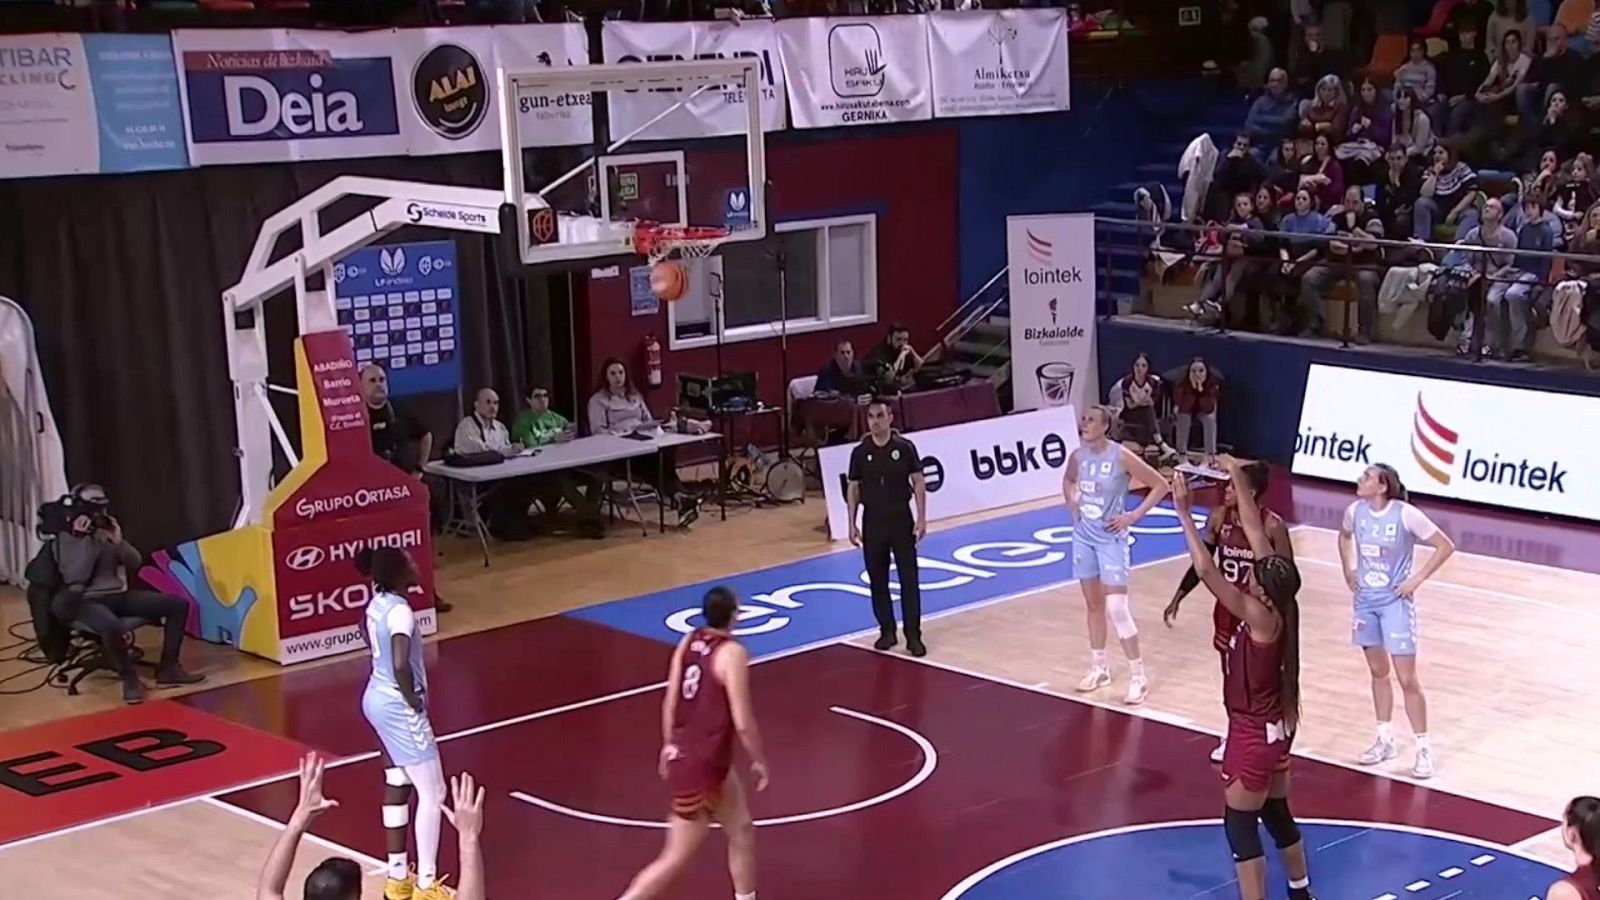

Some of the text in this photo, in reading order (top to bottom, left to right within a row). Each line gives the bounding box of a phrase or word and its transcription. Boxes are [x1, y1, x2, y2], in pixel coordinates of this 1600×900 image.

[429, 65, 476, 102] ALAI
[223, 73, 363, 137] Deia
[841, 110, 888, 122] GERNIKA
[458, 211, 487, 224] Sports
[1024, 266, 1083, 285] lointek
[1024, 326, 1085, 341] Bizkaialde
[323, 377, 352, 389] Barrio
[971, 441, 1040, 480] bbk
[1462, 449, 1568, 494] lointek
[296, 485, 411, 519] GRUPO ORTASA
[1223, 559, 1254, 584] 97
[682, 664, 702, 700] 8
